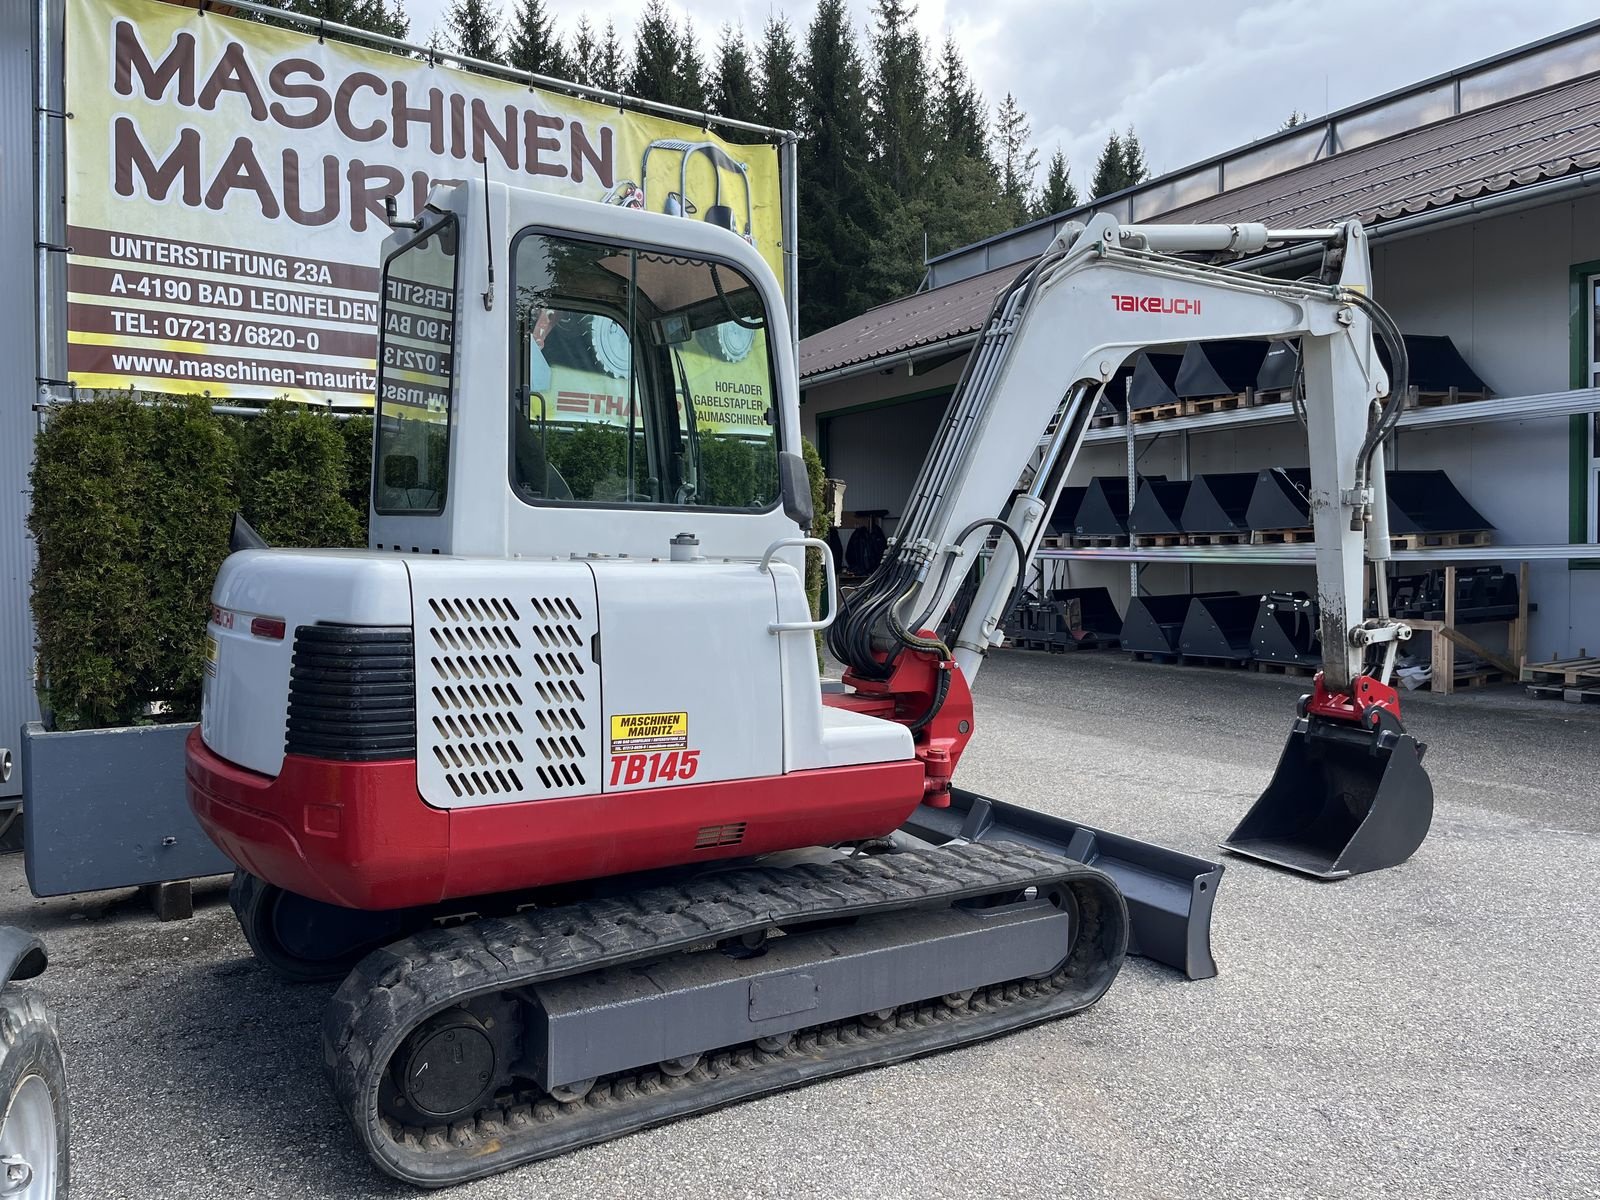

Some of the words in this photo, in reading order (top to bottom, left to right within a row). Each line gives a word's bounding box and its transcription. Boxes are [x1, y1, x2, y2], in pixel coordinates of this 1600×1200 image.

[114, 21, 614, 188] MASCHINEN
[110, 236, 288, 279] UNTERSTIFTUNG
[293, 262, 333, 285] 23A
[110, 273, 192, 301] A-4190
[198, 283, 243, 307] BAD
[250, 290, 377, 322] LEONFELDEN
[1111, 295, 1201, 315] TAKEUCHI
[111, 311, 159, 335] TEL:
[165, 317, 320, 350] 07213/6820-0
[694, 394, 763, 411] GABELSTAPLER
[715, 381, 763, 396] HOFLADER
[621, 715, 680, 727] MASCHINEN
[628, 726, 673, 737] MAURITZ
[610, 750, 700, 786] TB145
